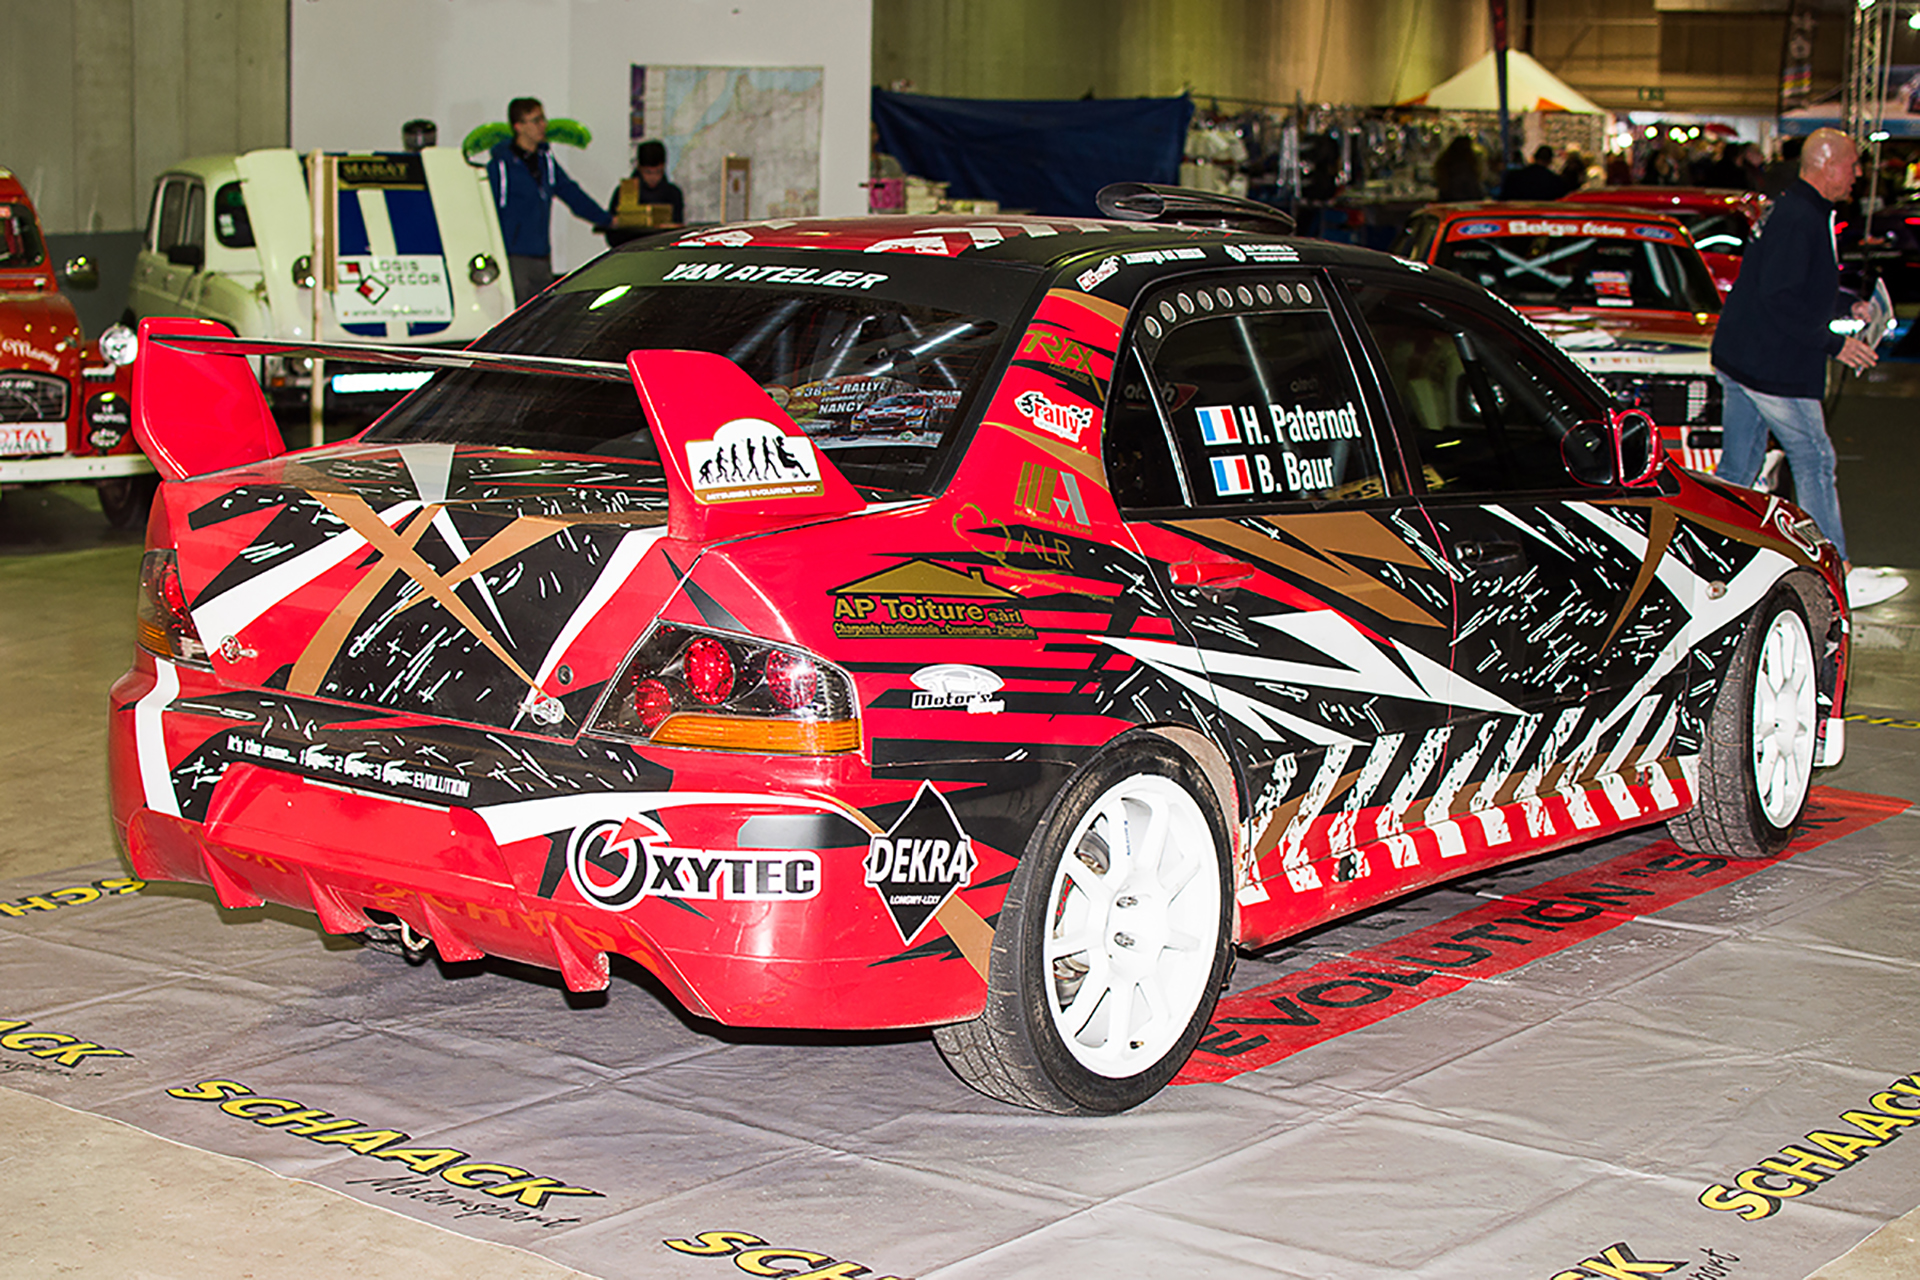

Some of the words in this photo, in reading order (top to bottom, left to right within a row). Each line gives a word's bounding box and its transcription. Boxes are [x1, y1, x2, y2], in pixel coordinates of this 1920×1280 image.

[385, 272, 441, 286] DECOR
[725, 265, 888, 290] ATELIER
[818, 402, 864, 414] NANCY
[1240, 406, 1270, 445] H.
[1269, 402, 1362, 444] Paternot
[1255, 454, 1282, 494] B.
[1283, 451, 1334, 492] Baur
[1021, 531, 1075, 570] ALR
[834, 598, 876, 620] AP
[881, 597, 984, 621] Toiture
[412, 770, 471, 798] EVOLUTION
[868, 838, 968, 883] DEKRA
[165, 1079, 607, 1210] SCHAACK
[346, 1176, 582, 1228] Motorsport
